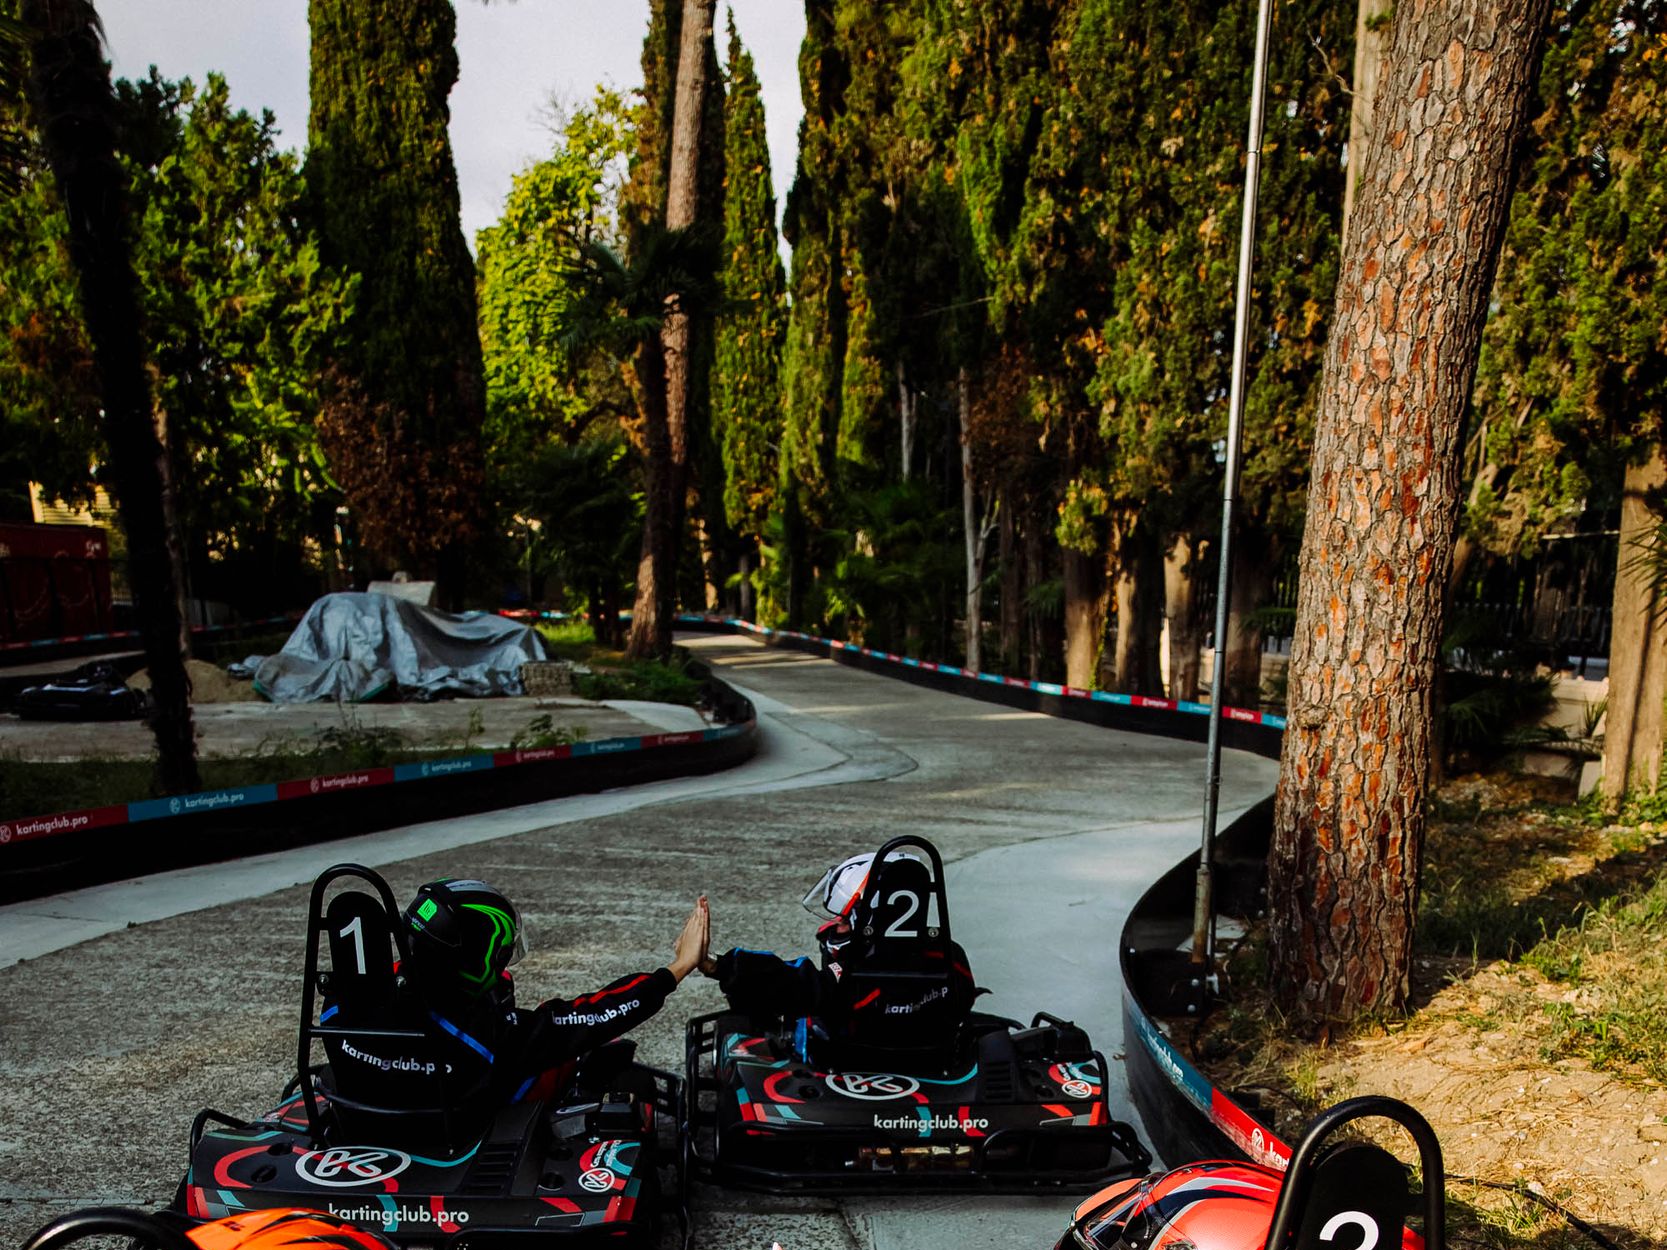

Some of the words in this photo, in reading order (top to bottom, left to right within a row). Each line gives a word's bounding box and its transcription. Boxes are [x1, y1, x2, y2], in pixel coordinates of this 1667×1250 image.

[185, 792, 245, 808] kartingclub.pro
[16, 815, 88, 836] kartingclub.pro
[884, 889, 920, 938] 2
[339, 916, 367, 975] 1
[873, 1114, 989, 1133] kartingclub.pro
[328, 1203, 470, 1227] kartingclub.pro
